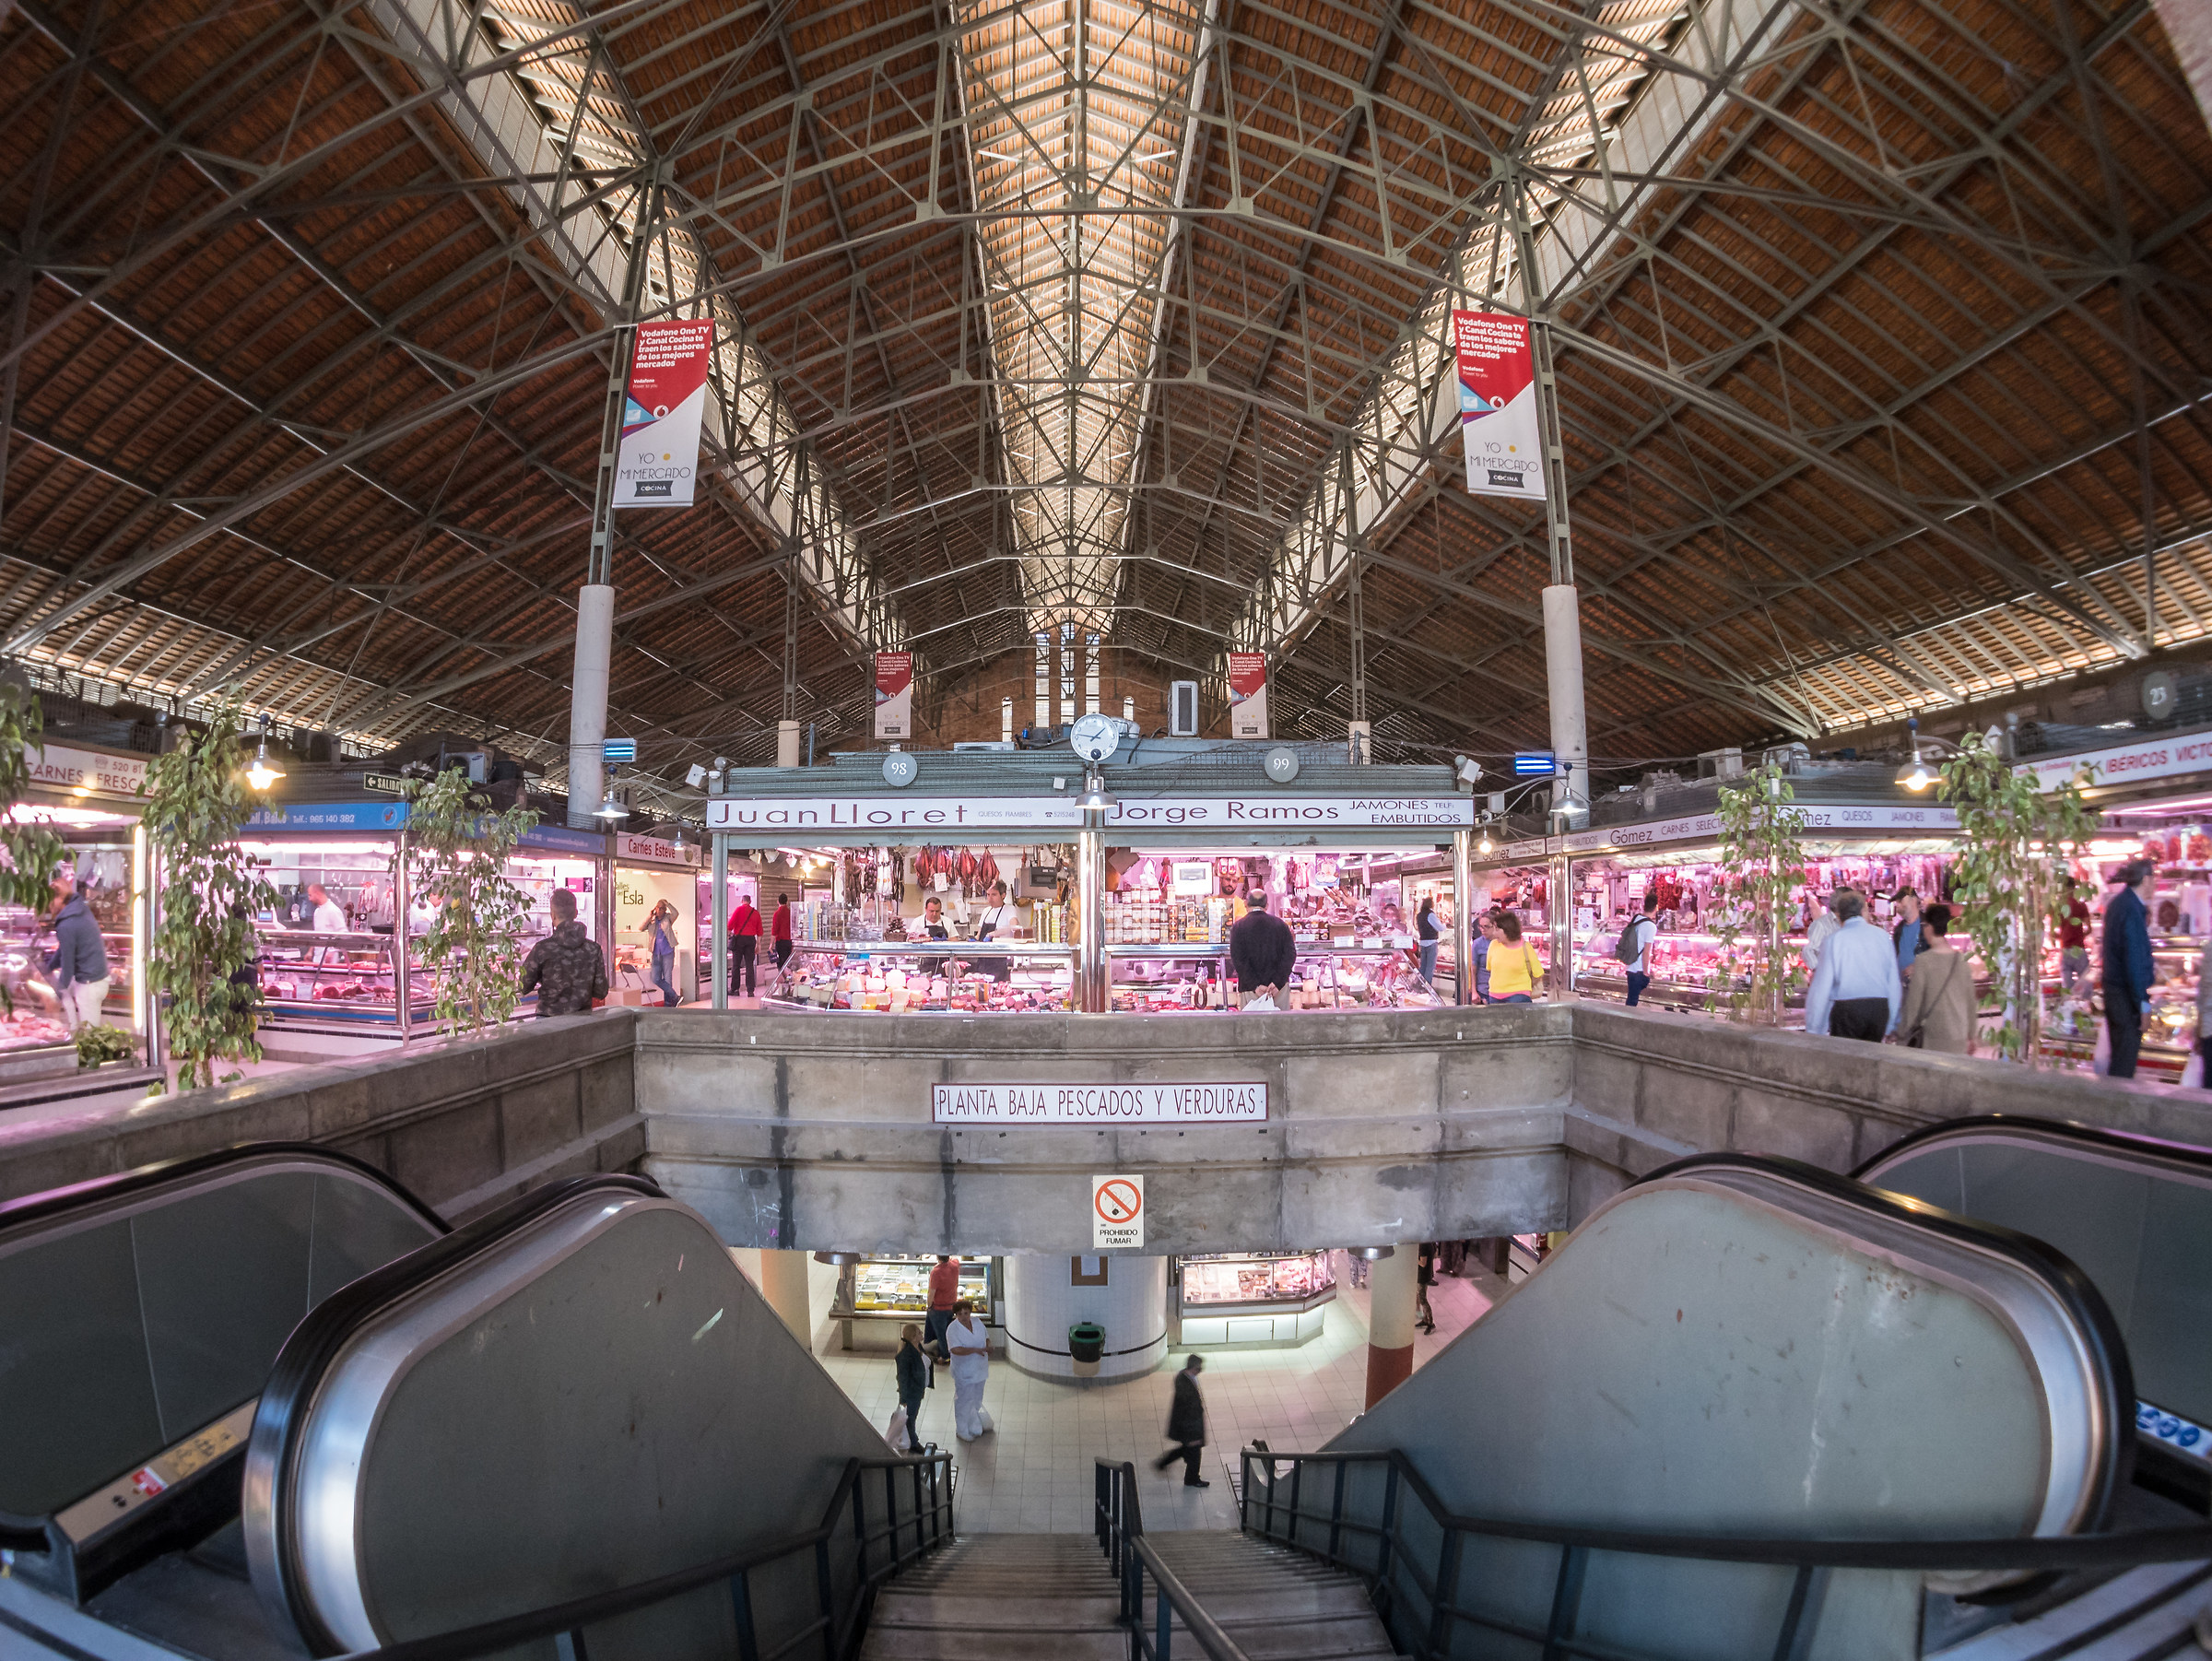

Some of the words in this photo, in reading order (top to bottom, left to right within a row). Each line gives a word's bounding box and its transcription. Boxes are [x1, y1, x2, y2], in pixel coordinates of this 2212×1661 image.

[641, 328, 678, 337] Vodafone
[679, 326, 696, 336] One
[697, 325, 710, 335] TV
[1458, 317, 1495, 329] Vodafone
[1496, 322, 1512, 330] One
[1512, 324, 1525, 333] TV
[1465, 326, 1488, 336] Canal
[1488, 328, 1513, 338] Cocina
[646, 336, 667, 345] Canal
[668, 335, 695, 344] Cocina
[696, 335, 703, 343] te
[1459, 334, 1480, 342] traen
[1480, 335, 1493, 343] los
[1493, 336, 1524, 348] sabores
[639, 345, 659, 353] traen
[659, 344, 671, 352] los
[672, 342, 705, 351] sabores
[1460, 340, 1470, 348] de
[1472, 341, 1484, 349] los
[1485, 344, 1517, 354] mejores
[637, 352, 648, 360] de
[649, 351, 661, 360] los
[662, 350, 695, 360] mejores
[1461, 349, 1500, 359] mercados
[636, 359, 676, 369] mercados
[1484, 442, 1501, 454] YO
[638, 453, 655, 465] YO
[1470, 455, 1481, 467] MI
[1482, 456, 1538, 473] MERCADO
[619, 468, 631, 480] MI
[632, 466, 691, 480] MERCADO
[112, 761, 129, 772] 520
[132, 762, 142, 773] 81
[1273, 758, 1289, 771] 99
[2106, 749, 2168, 773] IBÉRICOS
[891, 762, 907, 775] 98
[97, 772, 154, 794] FRESC
[377, 777, 400, 792] SALIDA
[325, 814, 338, 823] 140
[1110, 801, 1208, 824] Jorge
[1228, 801, 1338, 819] Ramos
[1349, 800, 1429, 810] JAMONES
[1371, 813, 1461, 824] EMBUTIDOS
[1842, 810, 1873, 821] QUESOS
[1891, 811, 1924, 822] JAMONES
[1610, 829, 1653, 845] Gómez
[1661, 822, 1689, 836] CARNES
[1696, 818, 1726, 831] SELECTA
[628, 839, 653, 856] Carnes
[654, 842, 676, 859] Esteve
[616, 881, 629, 890] alles
[623, 889, 644, 905] Esla
[939, 1090, 998, 1115] PLANTA
[1008, 1090, 1047, 1115] BAJA
[1058, 1090, 1143, 1116] PESCADOS
[1154, 1090, 1164, 1116] Y
[1173, 1088, 1256, 1115] VERDURAS
